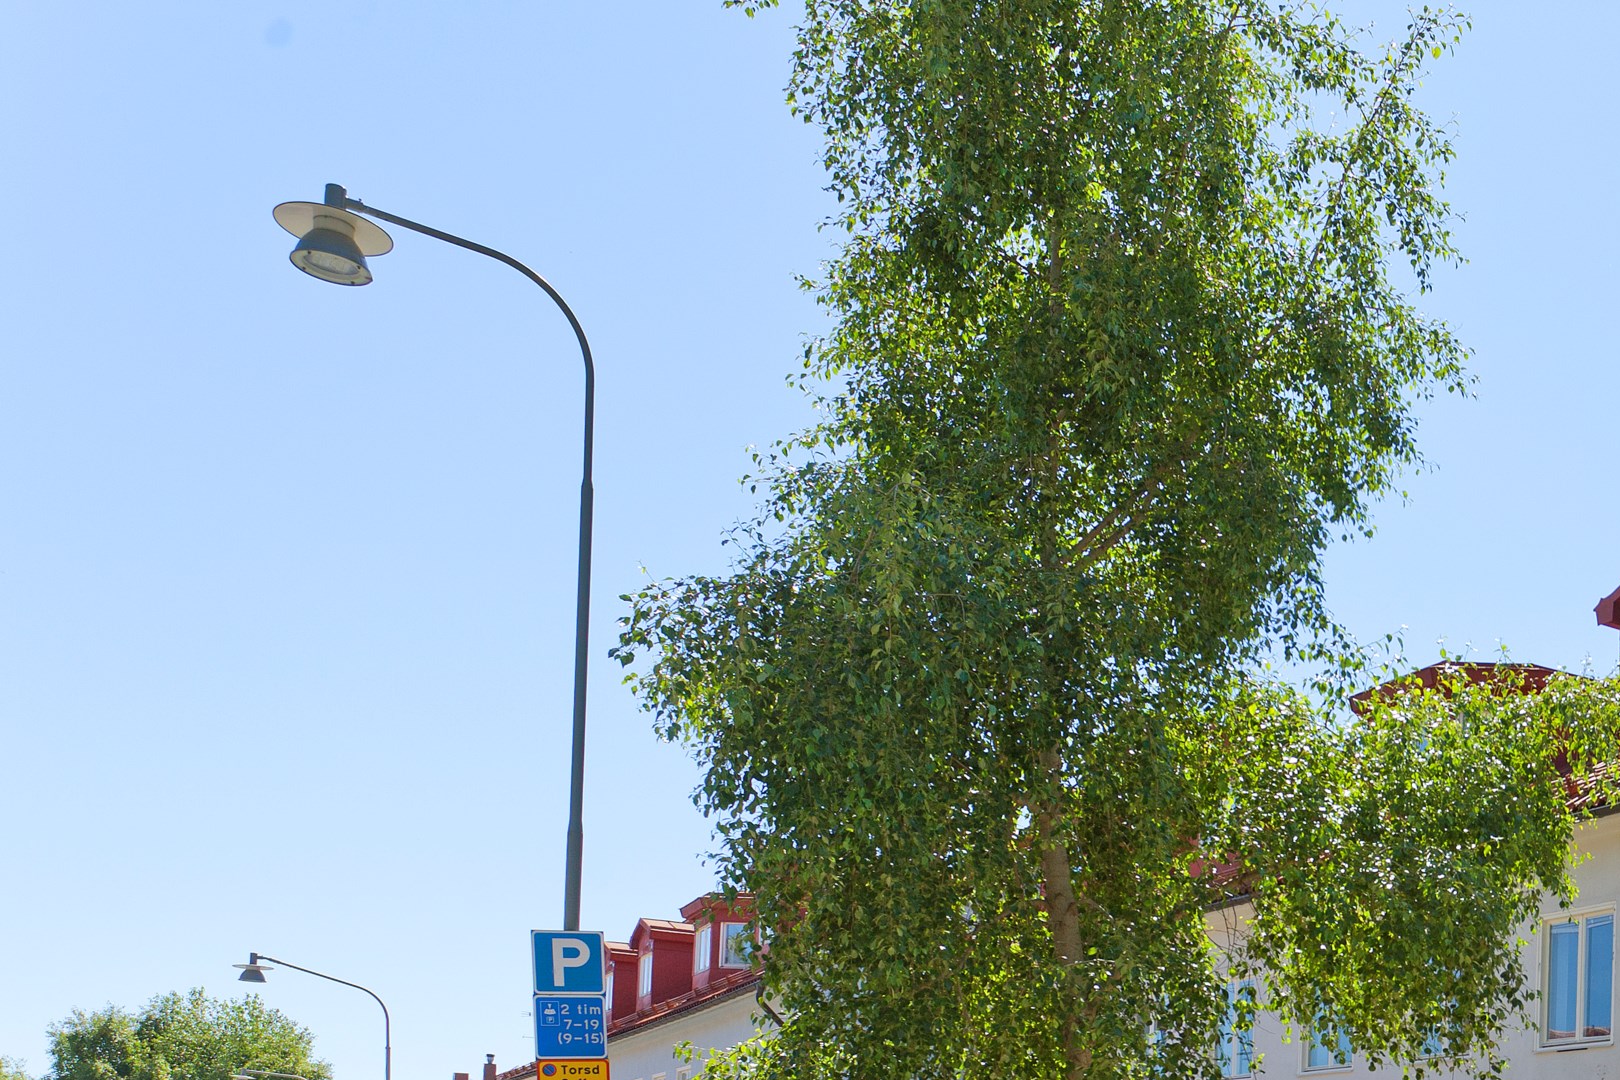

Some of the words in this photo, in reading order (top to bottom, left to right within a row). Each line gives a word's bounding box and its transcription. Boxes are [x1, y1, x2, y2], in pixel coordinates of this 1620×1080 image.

[551, 937, 591, 987] P
[560, 1004, 570, 1015] 2
[577, 1004, 601, 1015] tim
[563, 1019, 599, 1030] 7-19
[557, 1031, 604, 1045] (9-15)
[560, 1064, 600, 1075] Torsd
